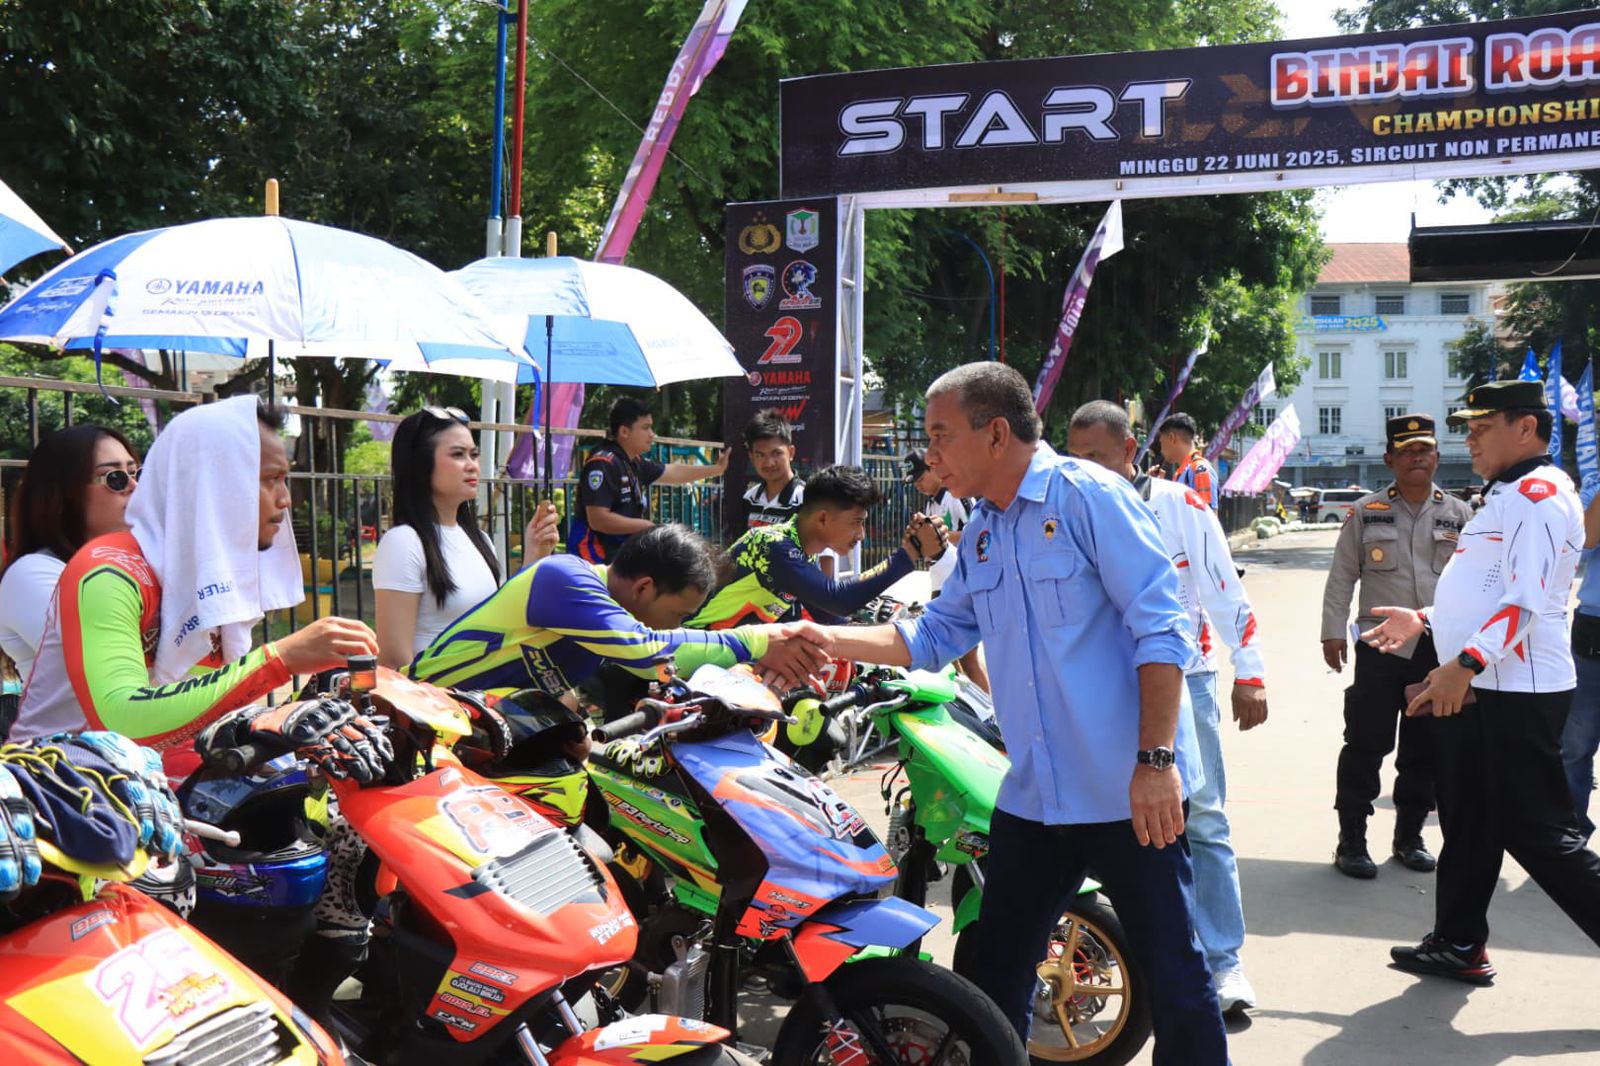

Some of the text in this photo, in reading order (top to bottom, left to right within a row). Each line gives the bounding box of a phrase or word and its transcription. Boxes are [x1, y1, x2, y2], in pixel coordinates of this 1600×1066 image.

[1271, 37, 1475, 105] BINJAI
[838, 78, 1193, 157] START
[1373, 98, 1600, 136] CHAMPIONSHI
[1119, 157, 1198, 175] MINGGU
[1204, 156, 1229, 171] 22
[1235, 153, 1279, 170] JUNI
[1351, 142, 1439, 163] SIRCUIT
[1444, 139, 1489, 156] NON
[176, 279, 264, 295] YAMAHA
[762, 370, 812, 385] YAMAHA
